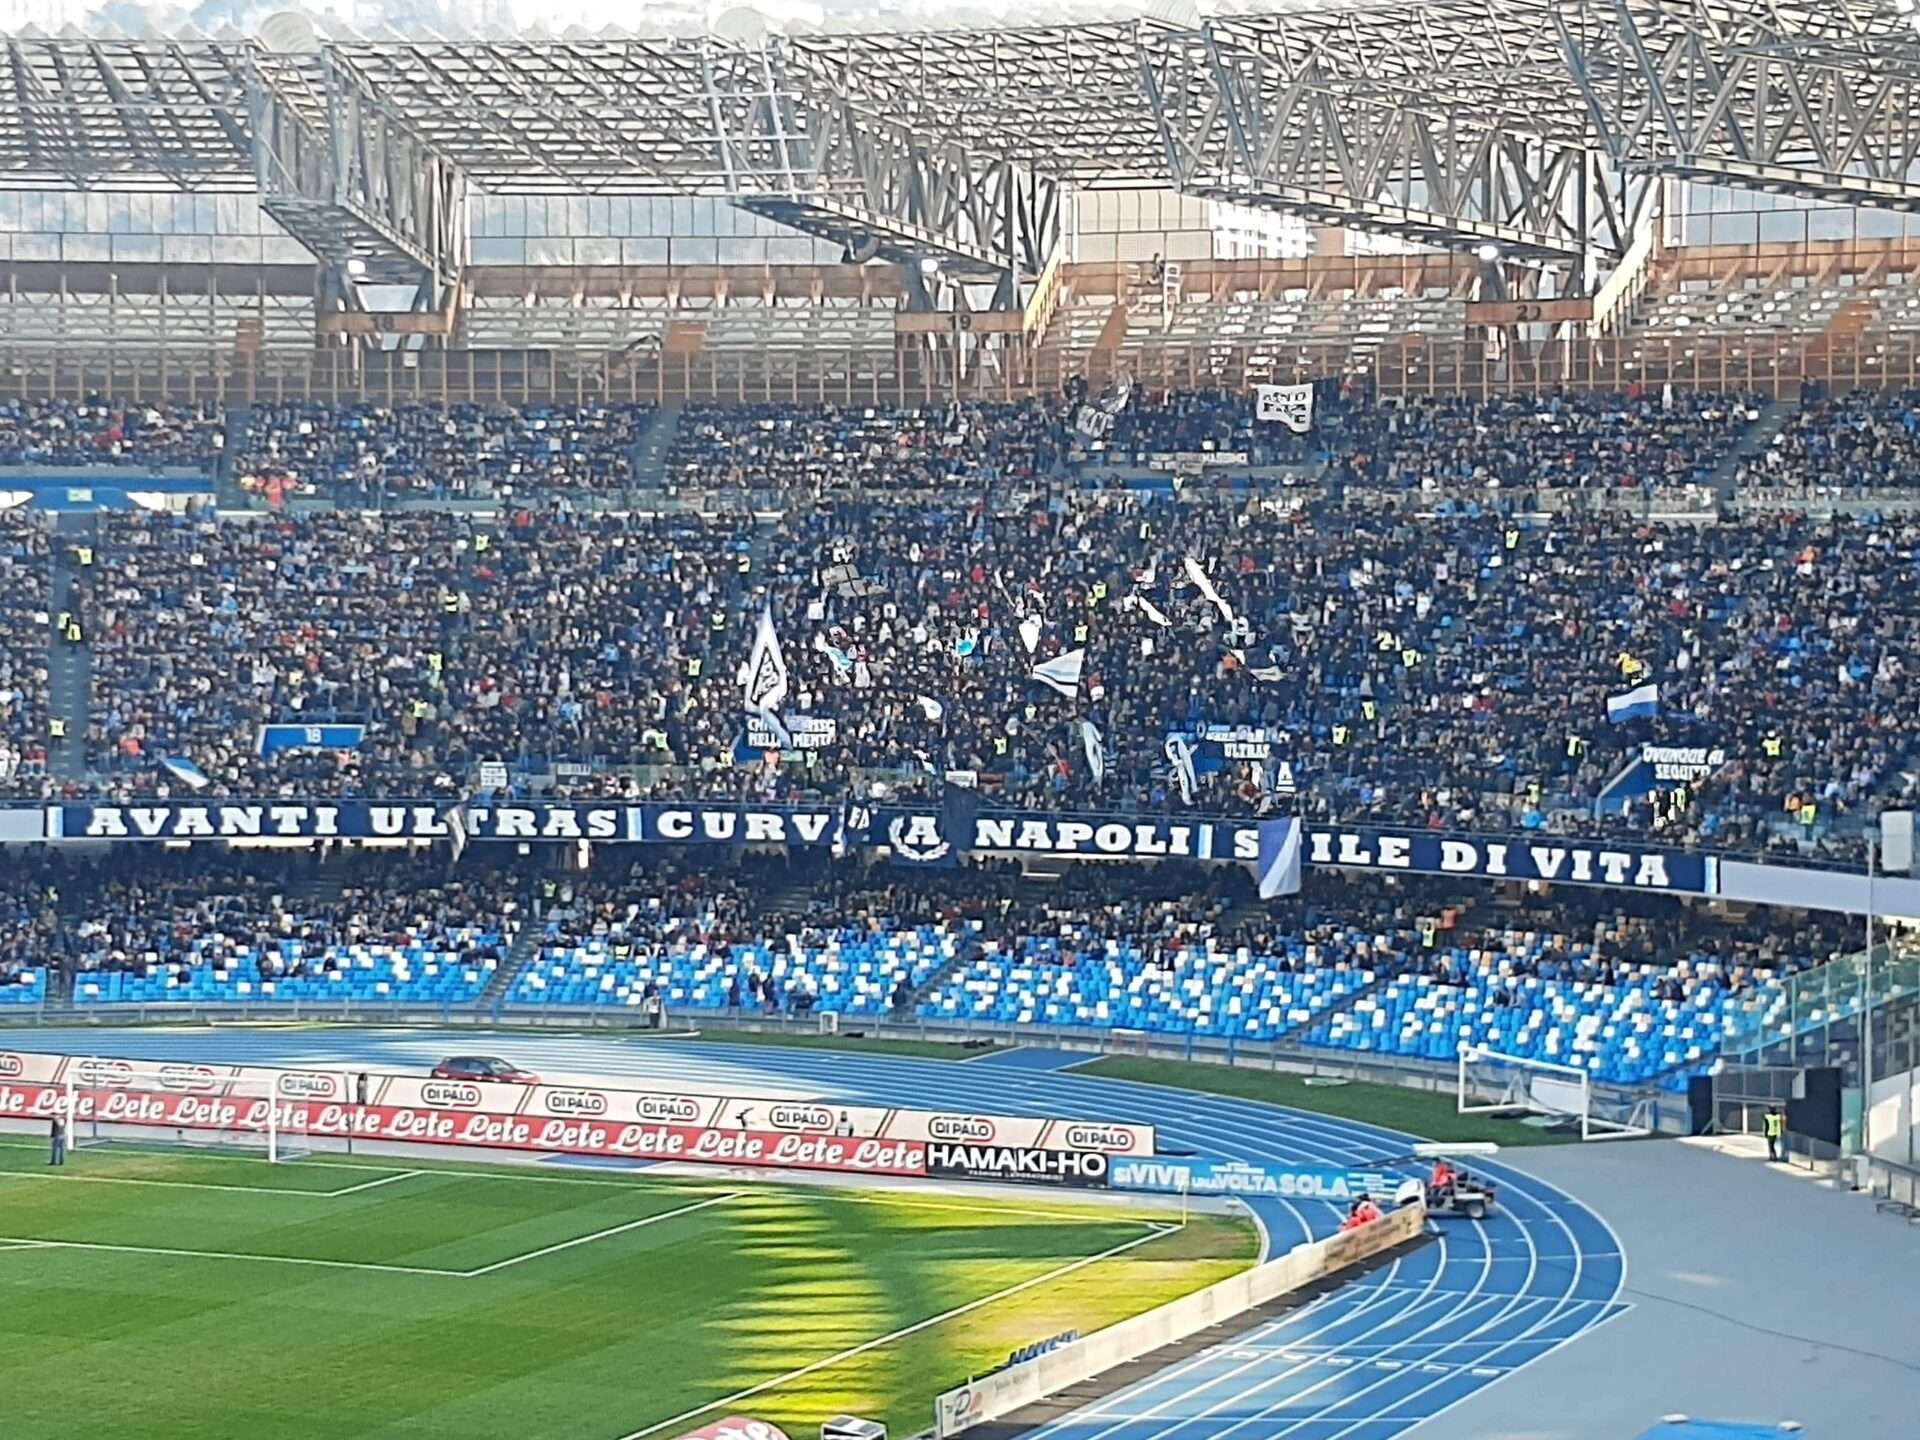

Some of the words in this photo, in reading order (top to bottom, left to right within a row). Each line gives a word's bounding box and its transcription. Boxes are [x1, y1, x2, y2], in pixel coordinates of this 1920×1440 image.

[947, 314, 972, 330] 19
[304, 727, 321, 743] 18
[1642, 746, 1707, 764] OVUNQUE
[86, 806, 338, 836] AVANTI
[369, 806, 617, 838] ULTRAS
[656, 810, 840, 841] CURV
[904, 816, 942, 846] A
[974, 819, 1190, 855] NAPOLI
[1234, 829, 1411, 867] SILE
[1441, 840, 1507, 874] DI
[1530, 846, 1670, 887] VITA
[427, 1089, 440, 1099] DI
[442, 1089, 475, 1102] PALO
[552, 1096, 565, 1107] DI
[568, 1097, 601, 1110] PALO
[643, 1102, 656, 1113] DI
[659, 1103, 694, 1116] PALO
[776, 1111, 789, 1122] DI
[793, 1112, 828, 1125] PALO
[0, 1087, 24, 1111] te
[97, 1092, 164, 1119] Lete
[166, 1096, 236, 1123] Lete
[237, 1100, 307, 1128] Lete
[309, 1105, 381, 1133] Lete
[381, 1109, 453, 1137] Lete
[456, 1114, 530, 1143] Lete
[531, 1119, 606, 1148] Lete
[608, 1124, 684, 1154] Lete
[686, 1129, 763, 1158] Lete
[765, 1134, 843, 1164] Lete
[844, 1140, 924, 1169] Lete
[935, 1122, 949, 1133] DI
[952, 1123, 989, 1137] PALO
[1073, 1131, 1088, 1142] DI
[1090, 1132, 1128, 1146] PALO
[927, 1143, 1107, 1177] HAMAKI-HO
[1129, 1163, 1190, 1187] VIVE
[1214, 1173, 1277, 1193] VOLTA
[1279, 1173, 1350, 1197] SOLA
